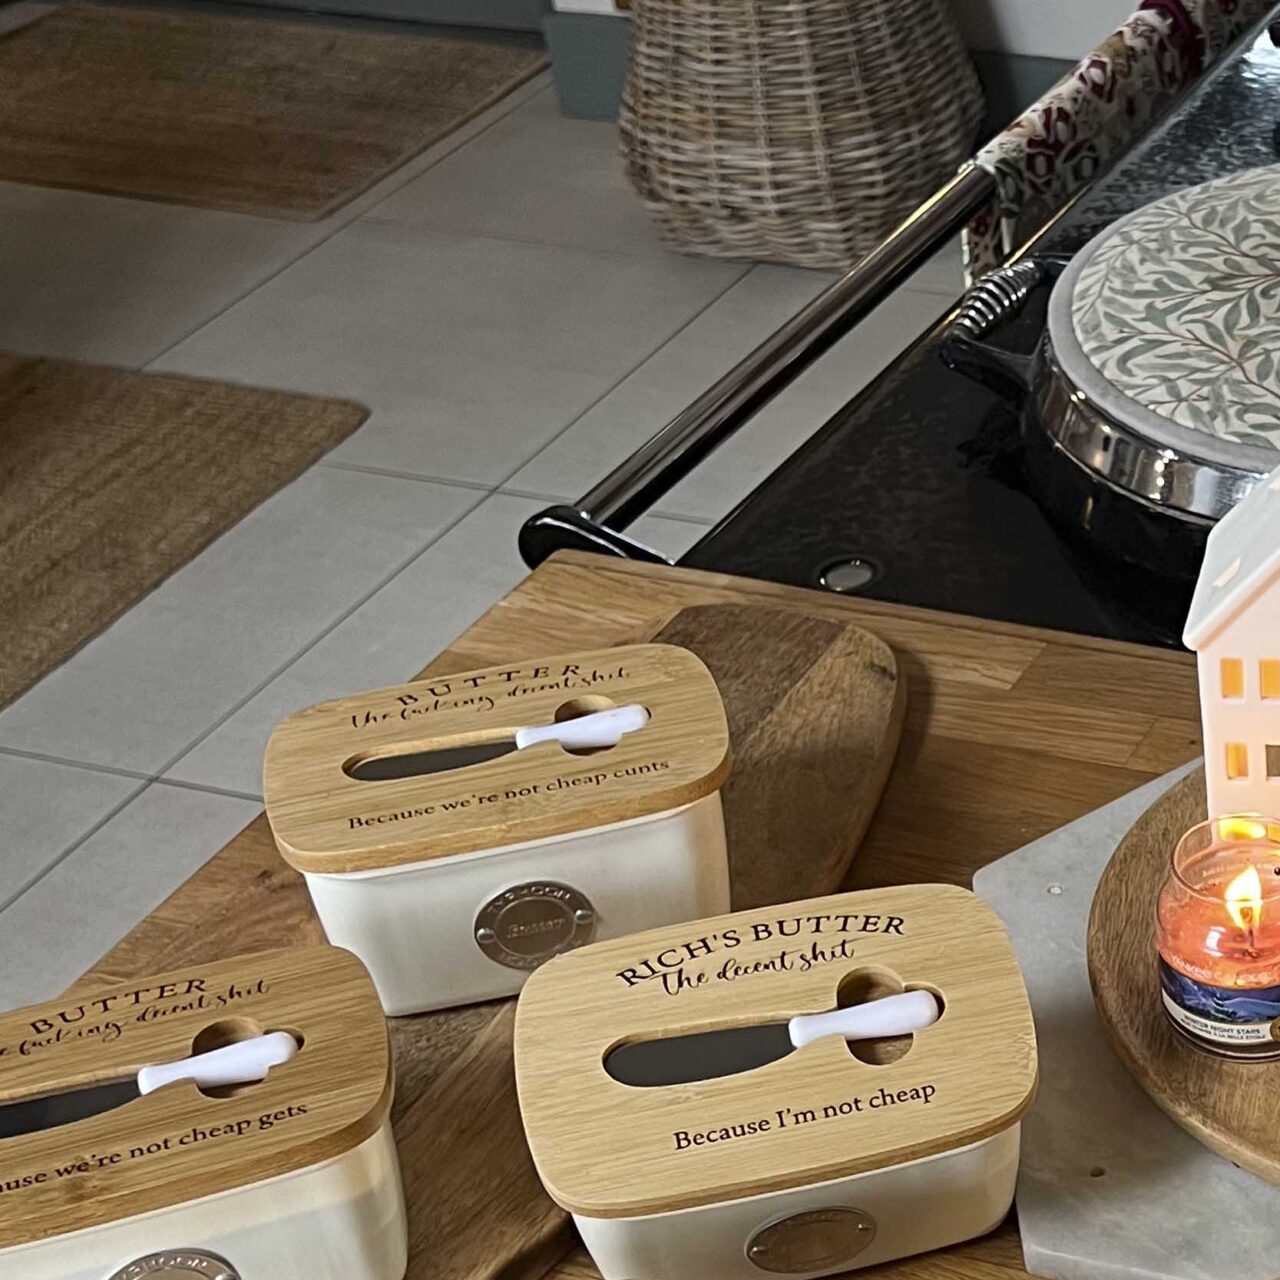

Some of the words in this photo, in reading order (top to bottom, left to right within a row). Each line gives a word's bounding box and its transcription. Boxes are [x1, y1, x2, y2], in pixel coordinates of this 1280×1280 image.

[397, 664, 581, 706] BUTTER
[348, 805, 436, 830] Because
[442, 793, 499, 813] we're
[504, 784, 541, 800] not
[545, 773, 608, 795] cheap
[613, 760, 670, 779] cunts
[615, 929, 742, 988] RICH'S
[750, 915, 906, 942] BUTTER
[655, 971, 709, 996] The
[716, 953, 793, 981] decent
[798, 938, 857, 971] shit
[29, 978, 208, 1035] BUTTER
[55, 1153, 122, 1178] we're
[129, 1137, 172, 1159] not
[178, 1119, 251, 1147] cheap
[258, 1103, 308, 1131] gets
[673, 1116, 771, 1151] Because
[776, 1107, 817, 1130] I'm
[822, 1097, 864, 1119] not
[868, 1083, 938, 1113] cheap
